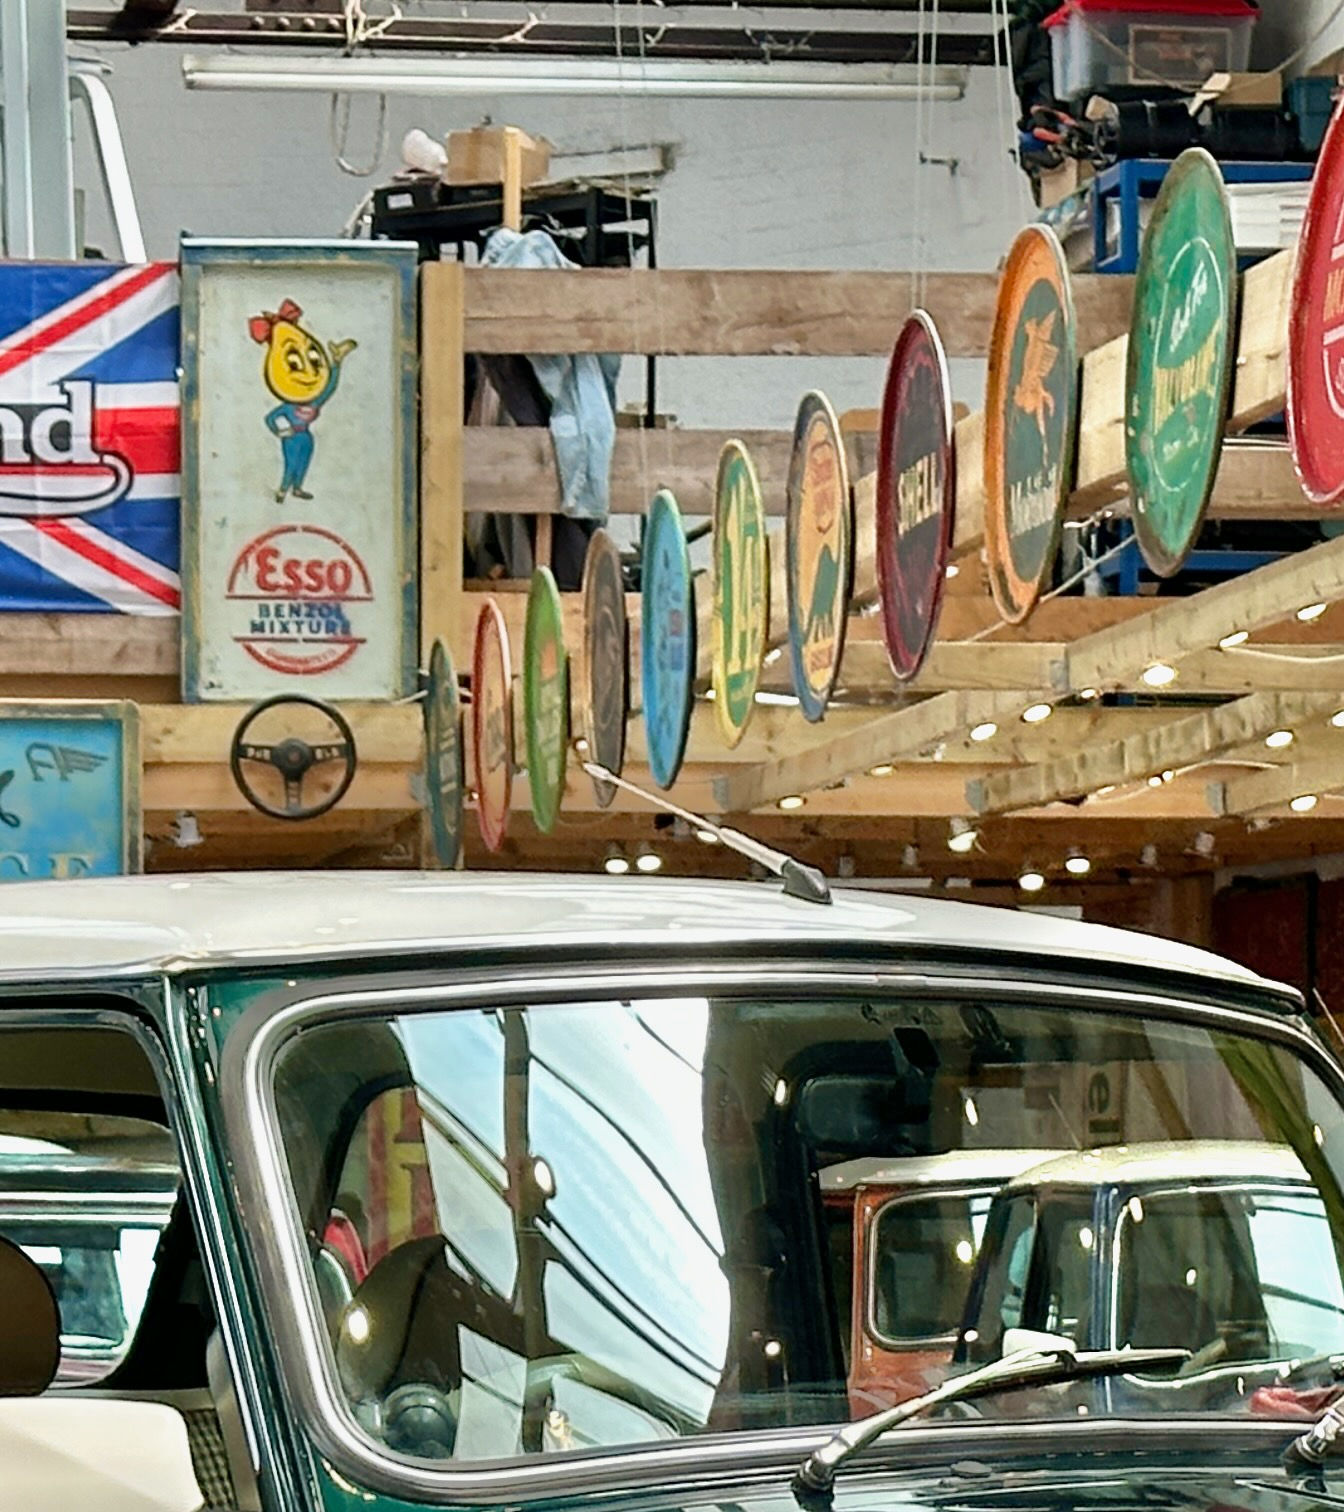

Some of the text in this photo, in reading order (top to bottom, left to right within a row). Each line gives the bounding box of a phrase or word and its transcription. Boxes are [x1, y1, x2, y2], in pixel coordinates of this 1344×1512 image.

[896, 452, 940, 542] SHELL
[255, 546, 353, 594] Esso
[249, 619, 352, 636] MIXTURE
